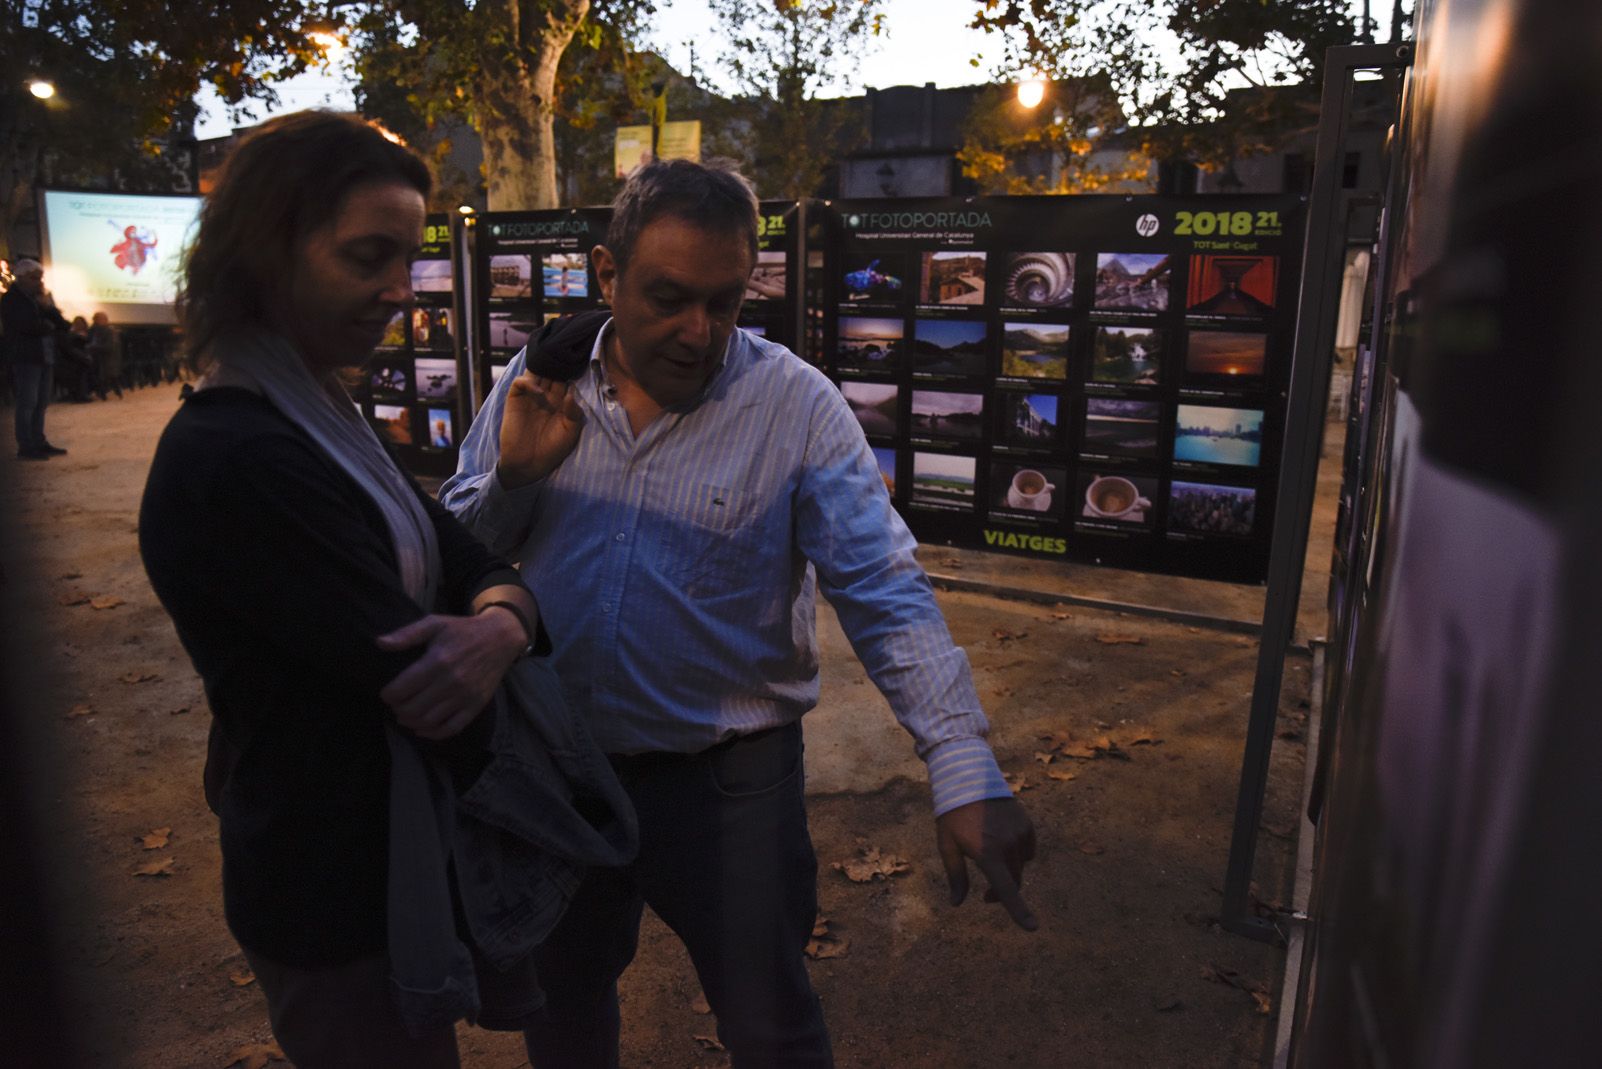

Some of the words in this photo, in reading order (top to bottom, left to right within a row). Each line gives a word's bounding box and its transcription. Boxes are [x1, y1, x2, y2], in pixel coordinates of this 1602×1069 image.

[1174, 210, 1253, 236] 2018
[1193, 241, 1211, 249] TOT
[983, 528, 1067, 554] VIATGES
